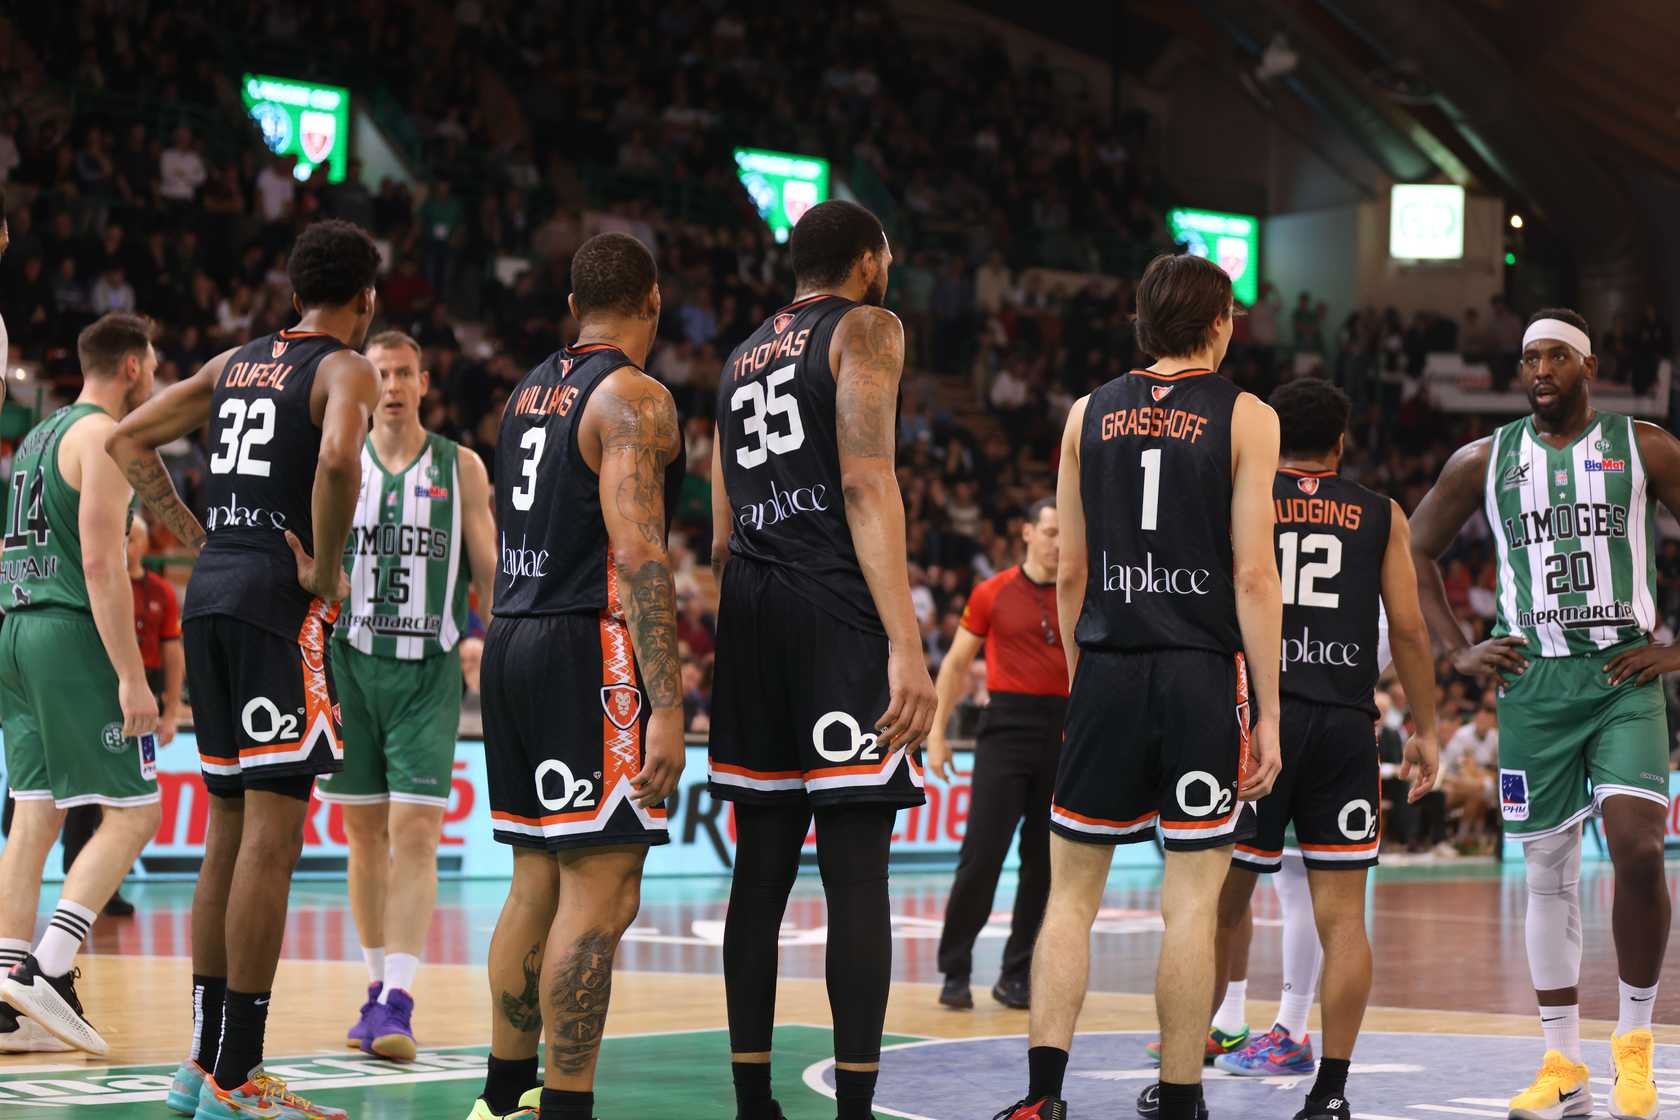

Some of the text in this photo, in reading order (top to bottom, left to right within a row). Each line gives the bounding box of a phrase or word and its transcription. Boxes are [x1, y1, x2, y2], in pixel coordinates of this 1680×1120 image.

[210, 398, 276, 477] 32
[731, 363, 805, 469] 35
[1101, 407, 1208, 443] GRASSHOFF
[511, 426, 547, 511] 3
[1140, 449, 1161, 531] 1
[1584, 458, 1625, 472] BigMat
[4, 466, 51, 551] 14
[740, 480, 828, 530] aplace
[1506, 502, 1627, 550] LIMOGES
[502, 530, 549, 588] laplae
[1103, 550, 1209, 603] laplace
[1279, 531, 1342, 608] 12
[1545, 551, 1595, 595] 20
[367, 568, 410, 604] 15
[1280, 626, 1360, 672] place
